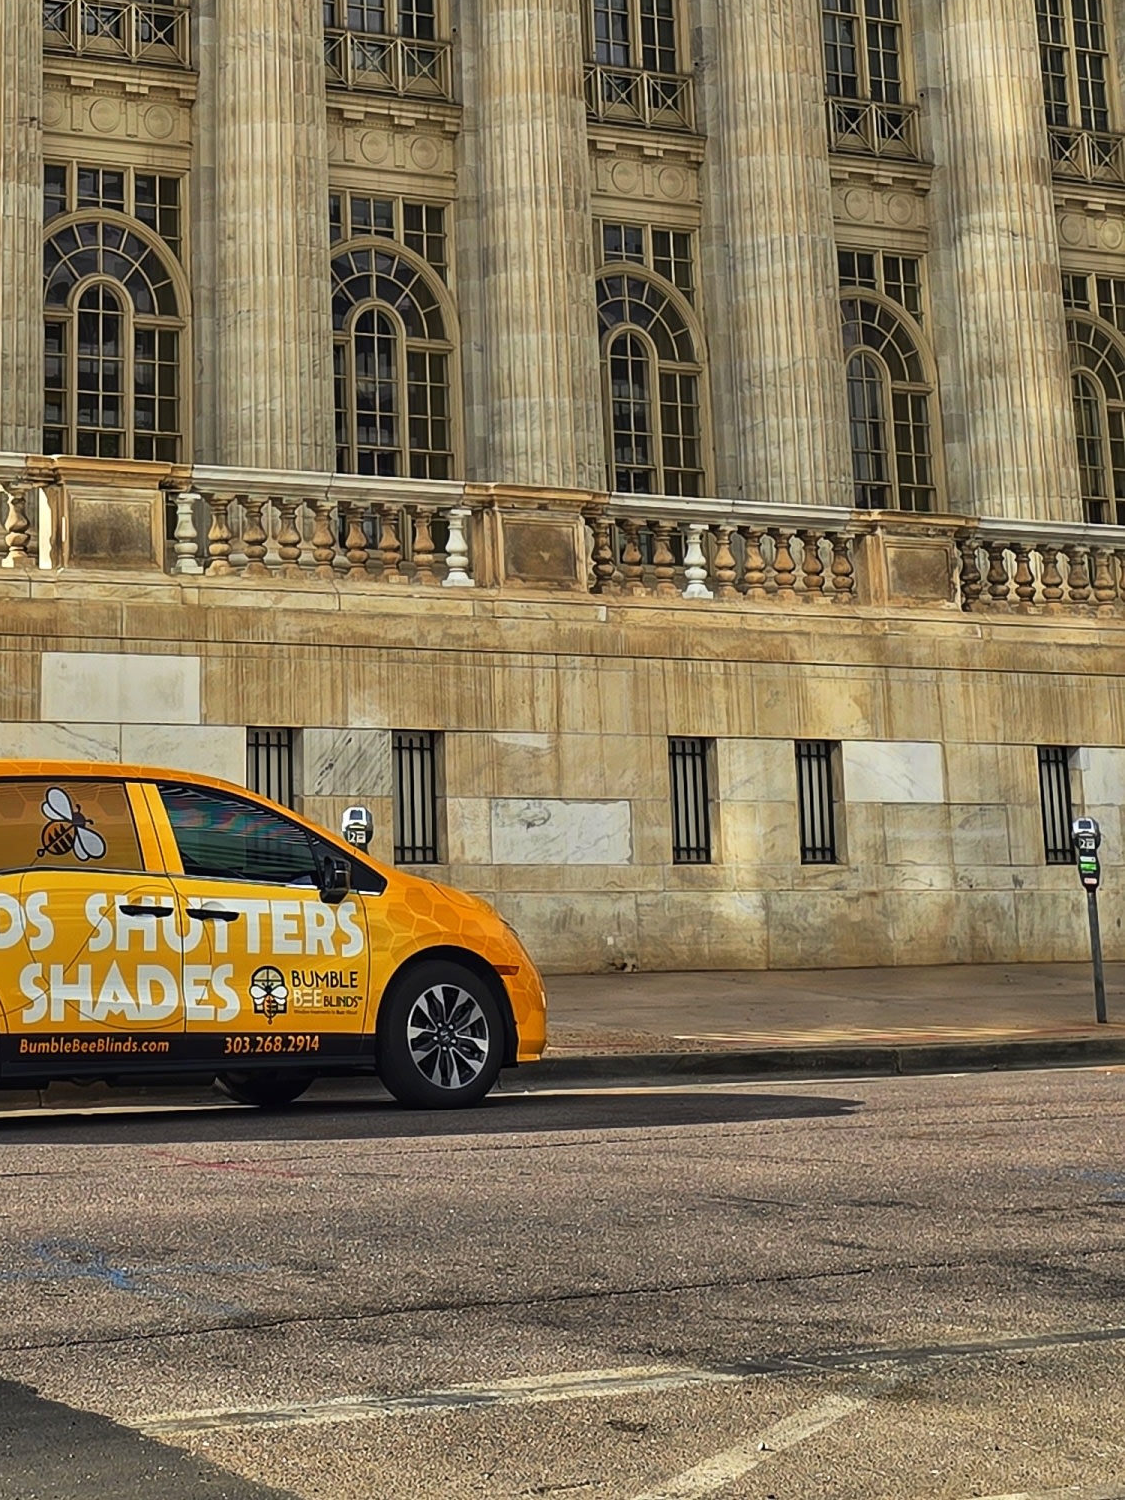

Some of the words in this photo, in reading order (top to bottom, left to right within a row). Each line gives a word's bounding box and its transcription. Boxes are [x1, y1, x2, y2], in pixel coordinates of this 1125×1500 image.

[85, 893, 365, 958] SHUTTERS
[291, 969, 359, 988] BUMBLE
[19, 960, 242, 1024] SHADES
[293, 989, 323, 1008] BEE
[19, 1036, 170, 1054] BumbleBeeBlinds.com
[224, 1035, 320, 1053] 303.268.2914
